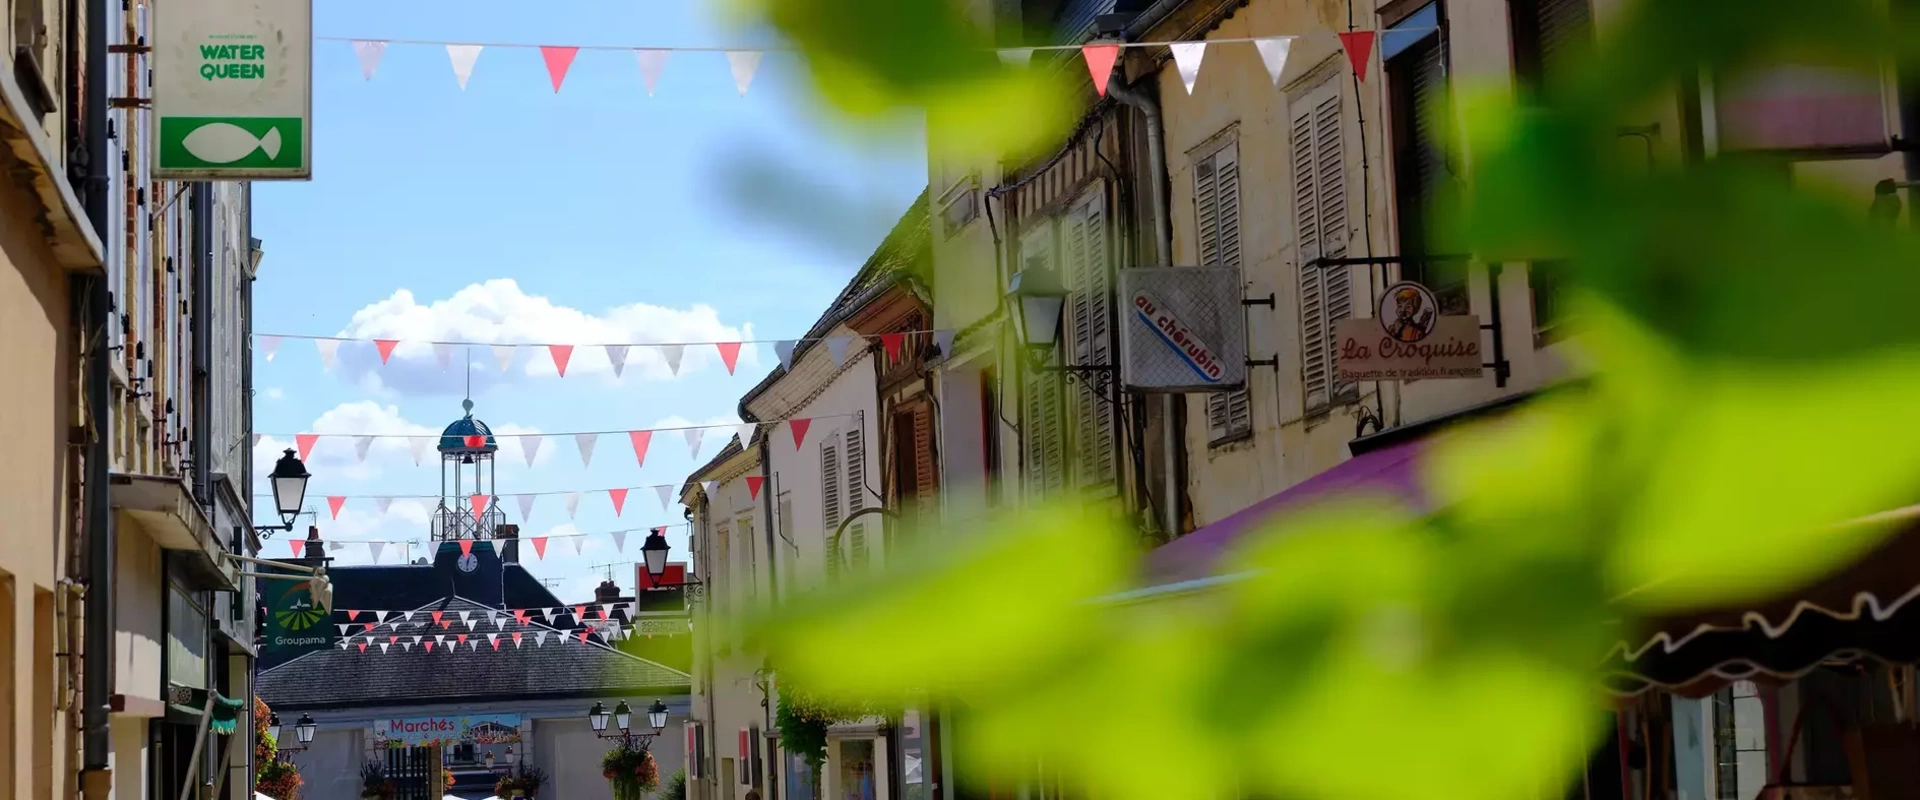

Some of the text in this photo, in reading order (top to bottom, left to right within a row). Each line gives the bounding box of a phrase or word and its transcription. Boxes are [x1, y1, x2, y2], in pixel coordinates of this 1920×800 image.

[200, 45, 264, 60] WATER
[200, 63, 264, 81] QUEEN
[1134, 296, 1221, 378] au chérubin
[1341, 336, 1479, 365] La Croquise
[1341, 368, 1383, 380] Baguette
[1385, 368, 1398, 378] de
[1400, 366, 1439, 377] tradition
[275, 636, 326, 647] Groupama
[391, 717, 455, 733] Marchés
